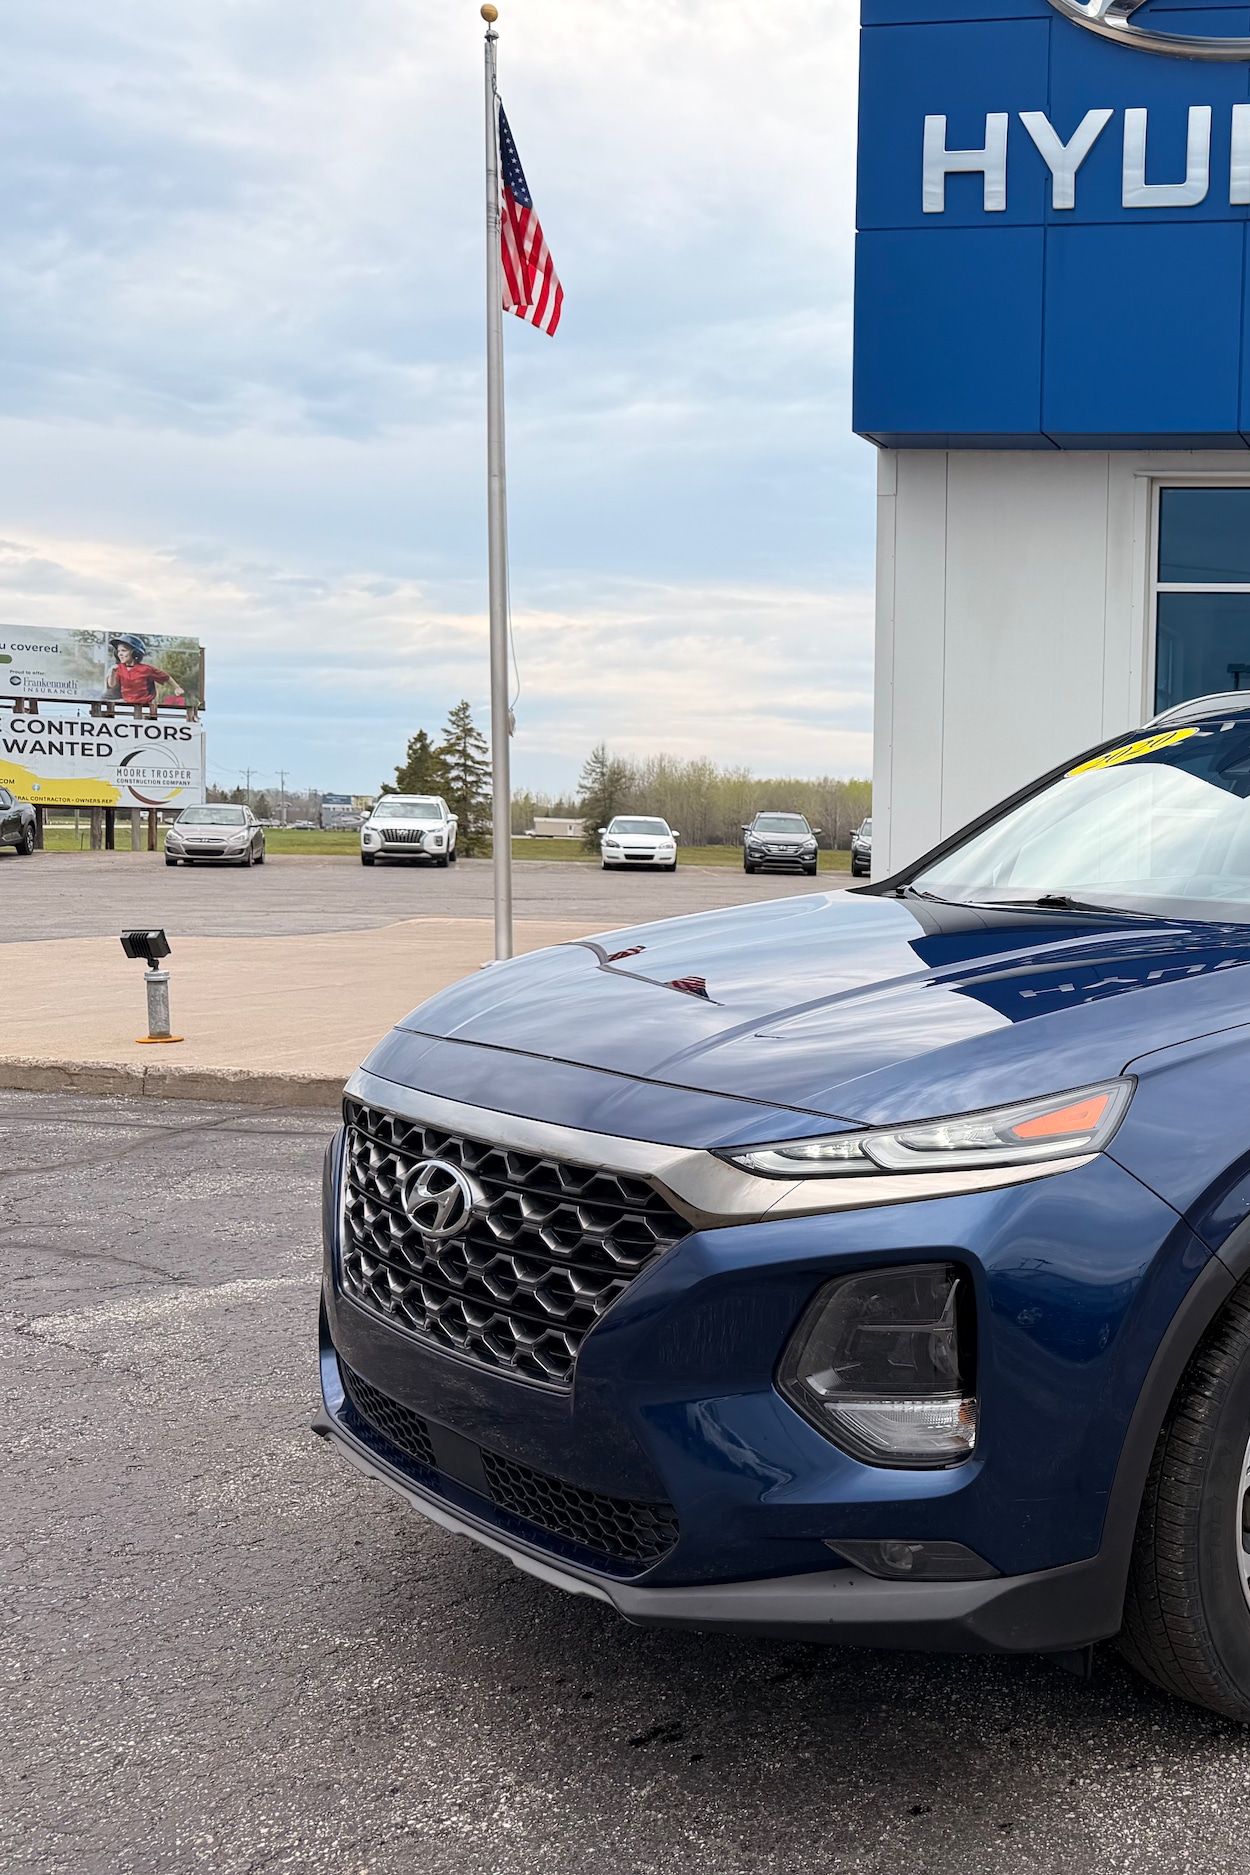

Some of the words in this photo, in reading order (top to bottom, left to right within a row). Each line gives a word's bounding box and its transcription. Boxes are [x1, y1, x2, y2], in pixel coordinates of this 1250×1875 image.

[10, 643, 62, 654] covered.
[23, 677, 78, 690] Frankenmuth
[23, 687, 77, 695] INSURANCE
[10, 718, 193, 741] CONTRACTORS
[2, 738, 113, 758] WANTED
[116, 768, 147, 778] MOORE
[151, 769, 191, 780] TROSPER
